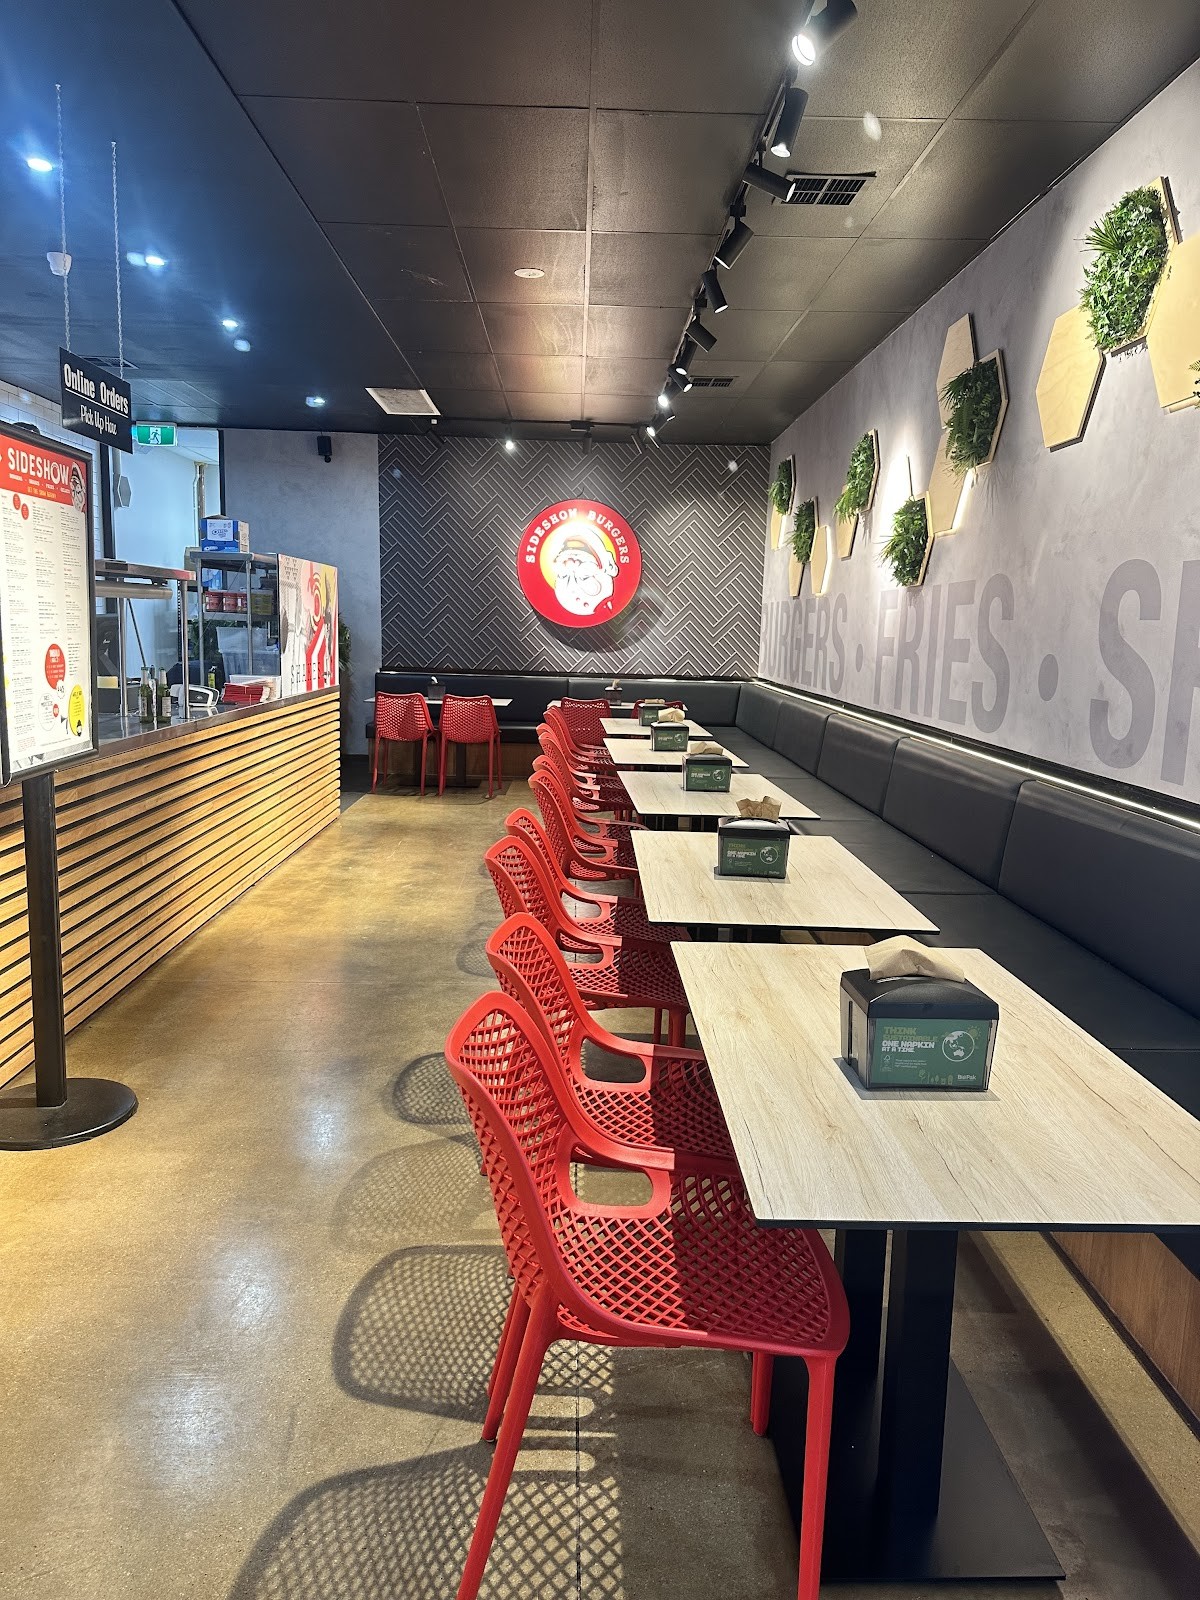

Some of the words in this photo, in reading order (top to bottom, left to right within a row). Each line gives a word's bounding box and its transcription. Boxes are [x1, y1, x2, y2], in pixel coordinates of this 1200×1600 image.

[63, 363, 96, 399] Online
[100, 381, 129, 415] Orders
[80, 404, 94, 426] Pick
[94, 410, 105, 434] Up
[7, 447, 70, 486] SIDESHOW
[525, 508, 578, 564] SIDESHOW
[588, 510, 630, 564] BURGERS
[759, 591, 848, 695] BURGERS
[873, 572, 1015, 734] FRIES
[882, 1040, 900, 1048] ONE
[900, 1041, 936, 1049] NAPKIN
[883, 1026, 917, 1035] THINK
